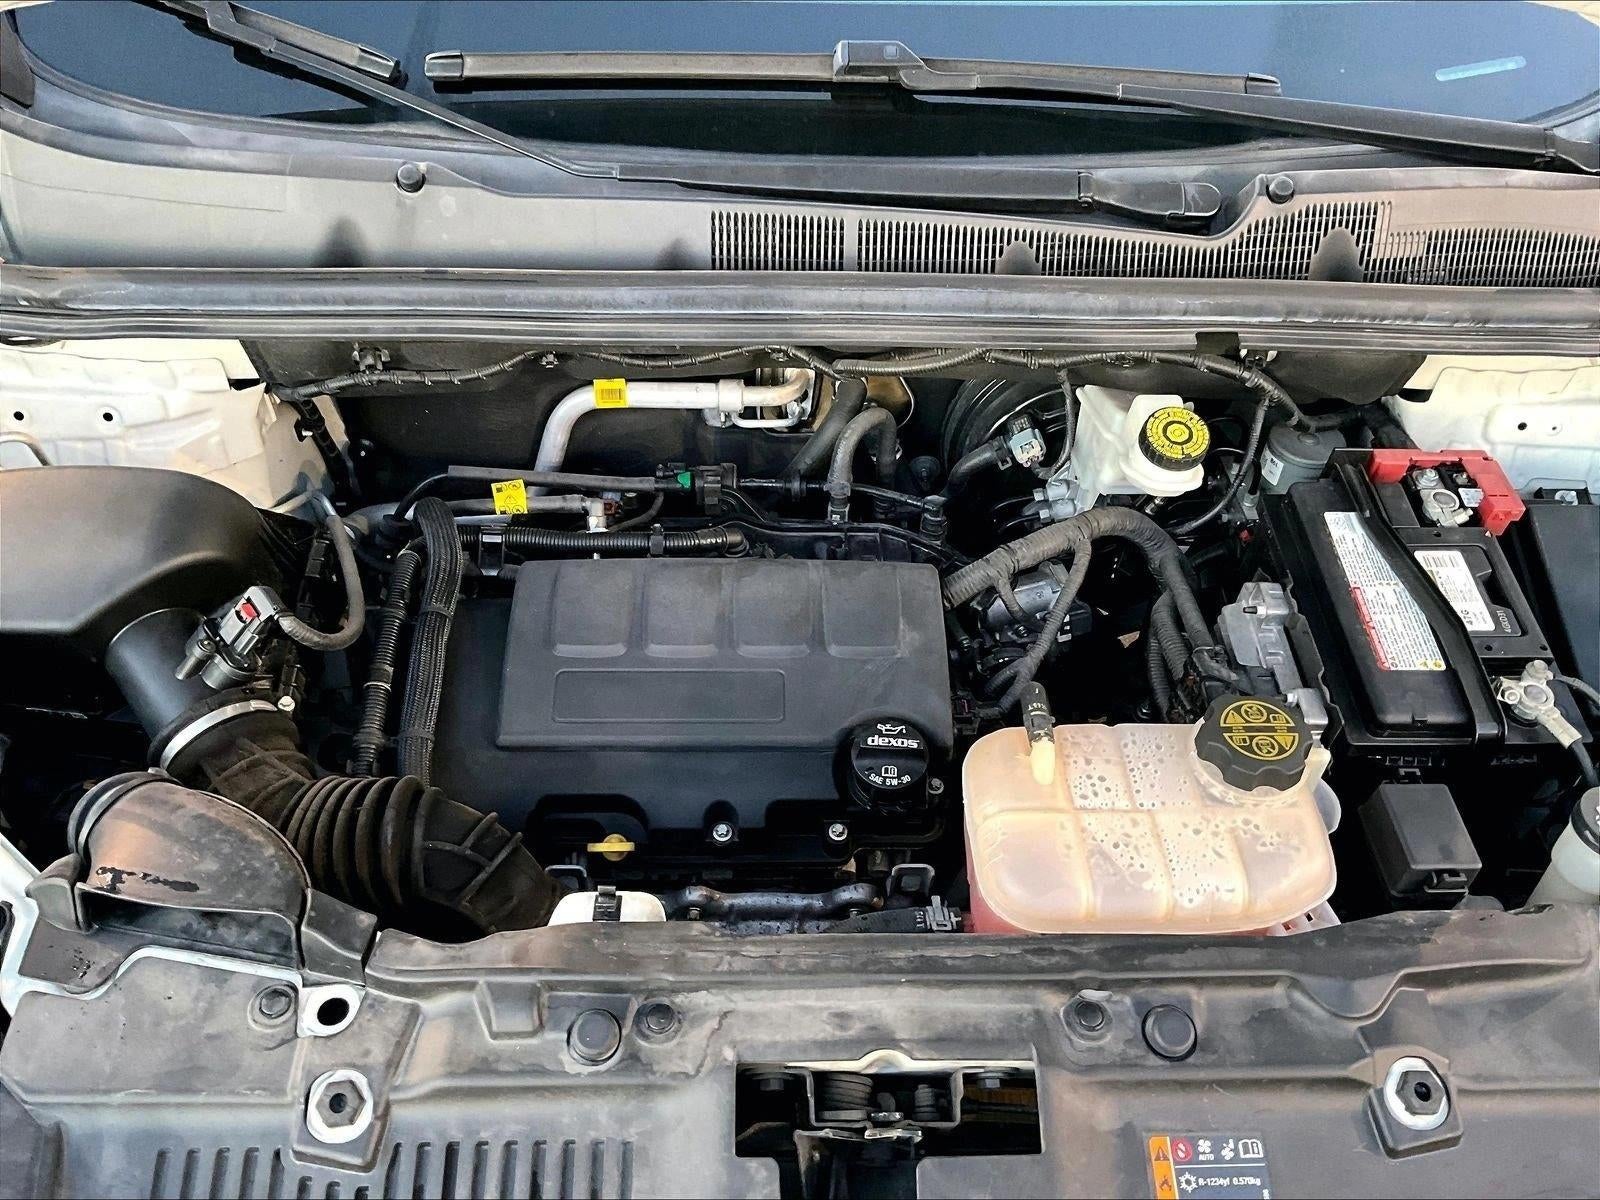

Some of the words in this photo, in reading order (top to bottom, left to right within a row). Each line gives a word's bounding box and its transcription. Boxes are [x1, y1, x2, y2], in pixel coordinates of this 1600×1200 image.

[867, 734, 920, 749] dexos
[868, 773, 883, 785] SAE
[885, 774, 911, 786] 5W-30
